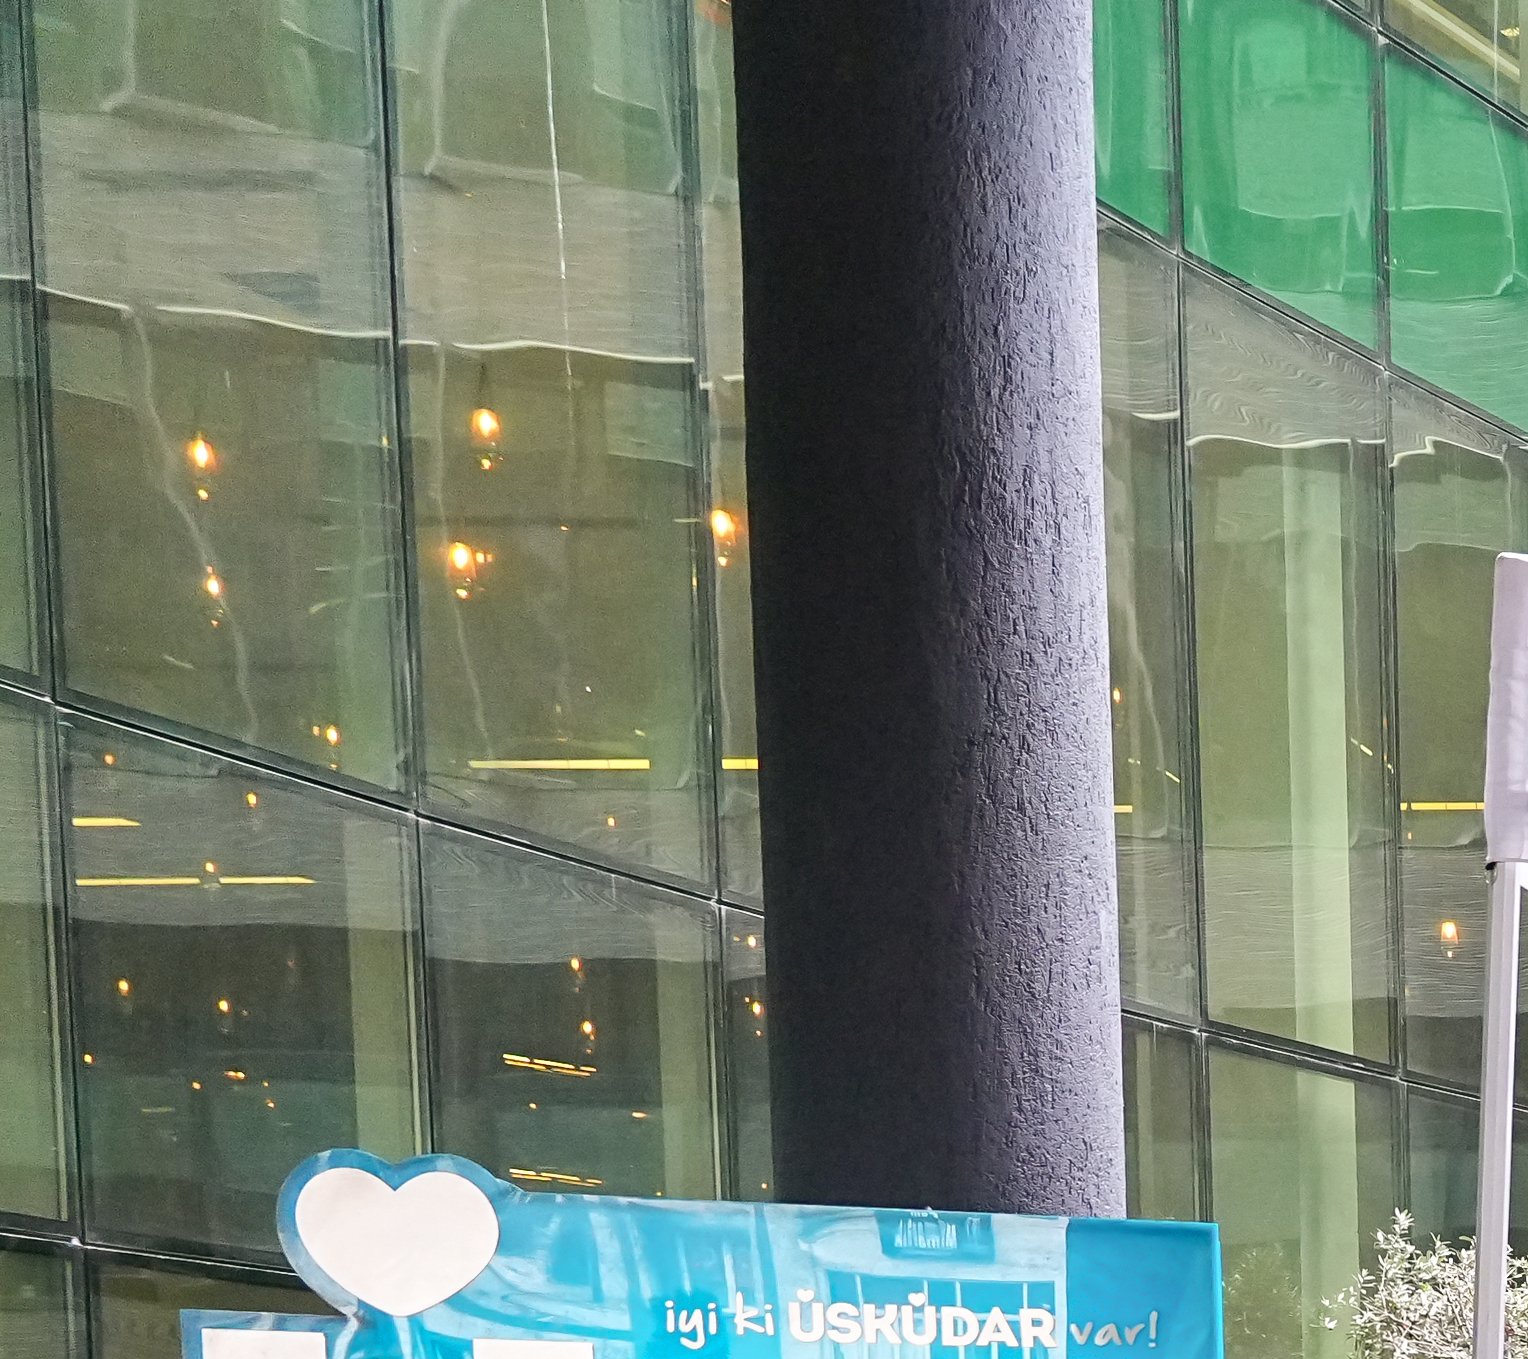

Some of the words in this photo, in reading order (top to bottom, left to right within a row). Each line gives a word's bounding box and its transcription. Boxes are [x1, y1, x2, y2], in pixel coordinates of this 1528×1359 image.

[664, 1300, 718, 1350] iyi
[733, 1290, 775, 1337] ki
[788, 1289, 1058, 1349] ÜSKÜDAR
[1069, 1310, 1159, 1348] var!
